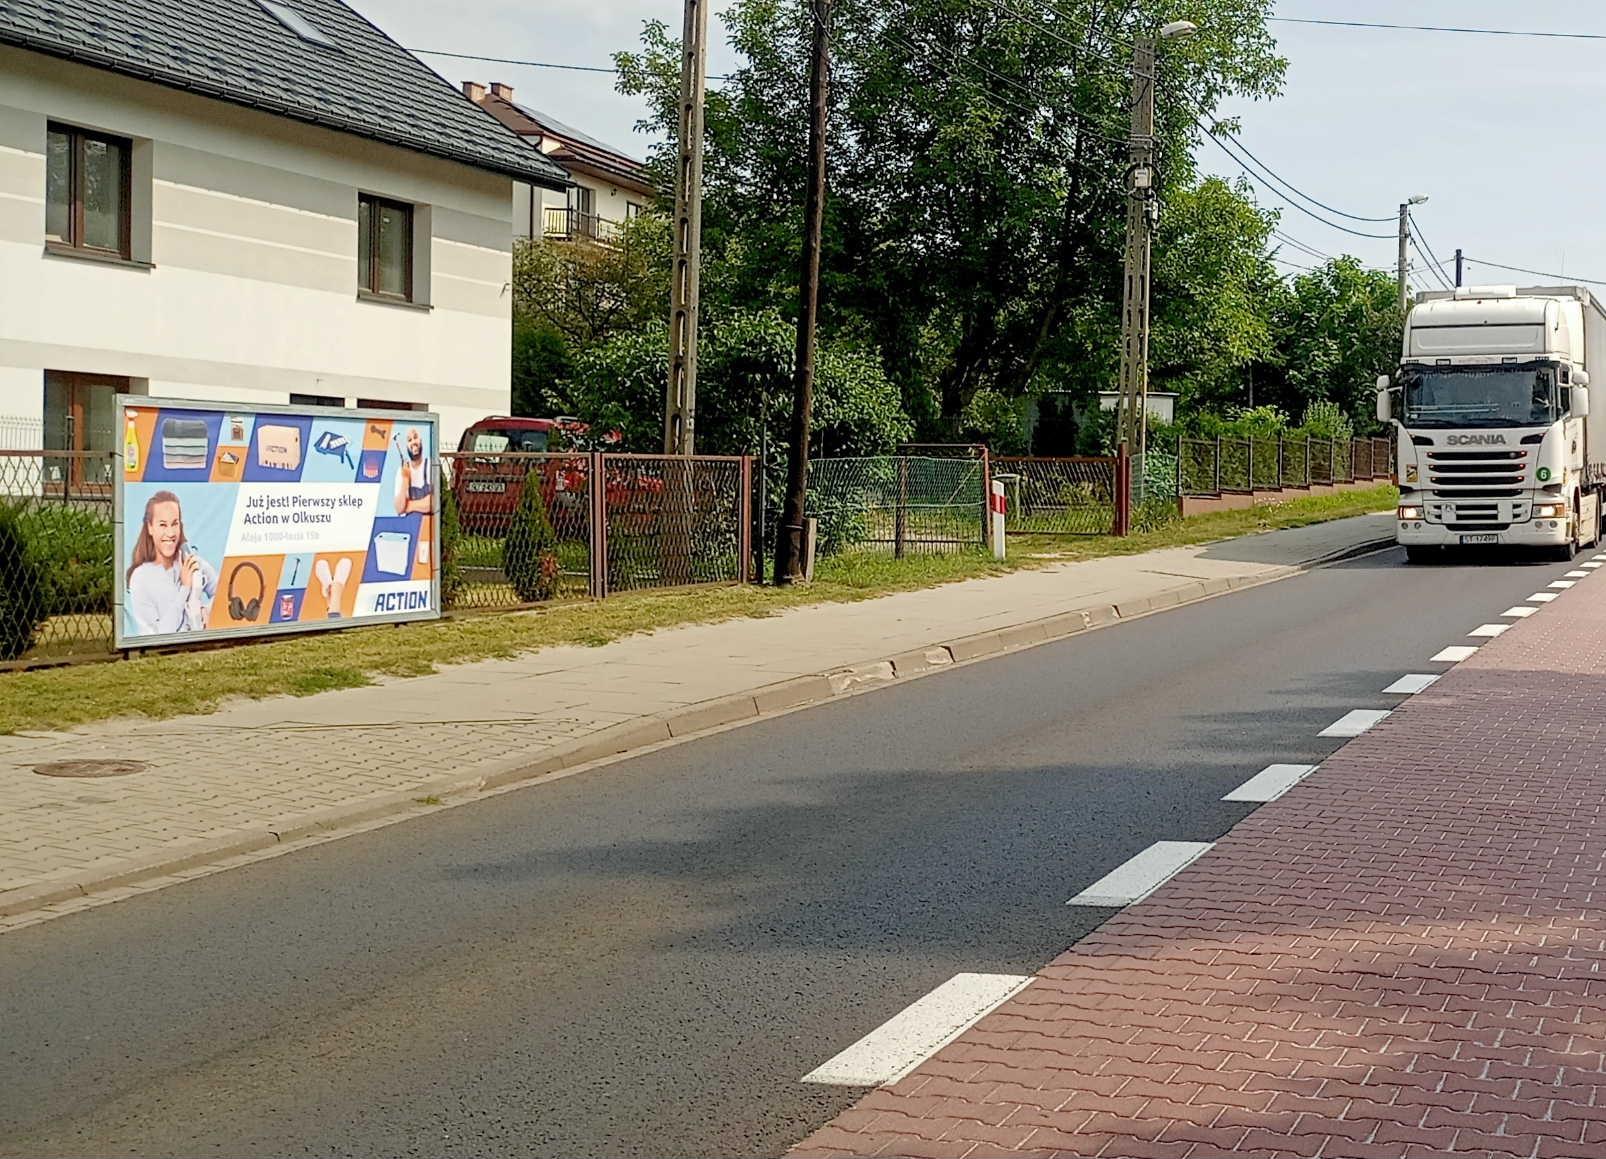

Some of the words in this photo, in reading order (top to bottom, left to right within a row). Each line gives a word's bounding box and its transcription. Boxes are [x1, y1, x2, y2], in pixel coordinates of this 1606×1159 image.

[1447, 434, 1506, 445] SCANIA
[246, 495, 264, 508] Już
[266, 495, 289, 510] jest!
[292, 494, 336, 509] Pierwszy
[338, 494, 363, 508] sklep
[244, 512, 279, 525] Action
[281, 514, 290, 523] w
[292, 511, 332, 524] Olkuszu
[374, 590, 428, 612] ACTION
